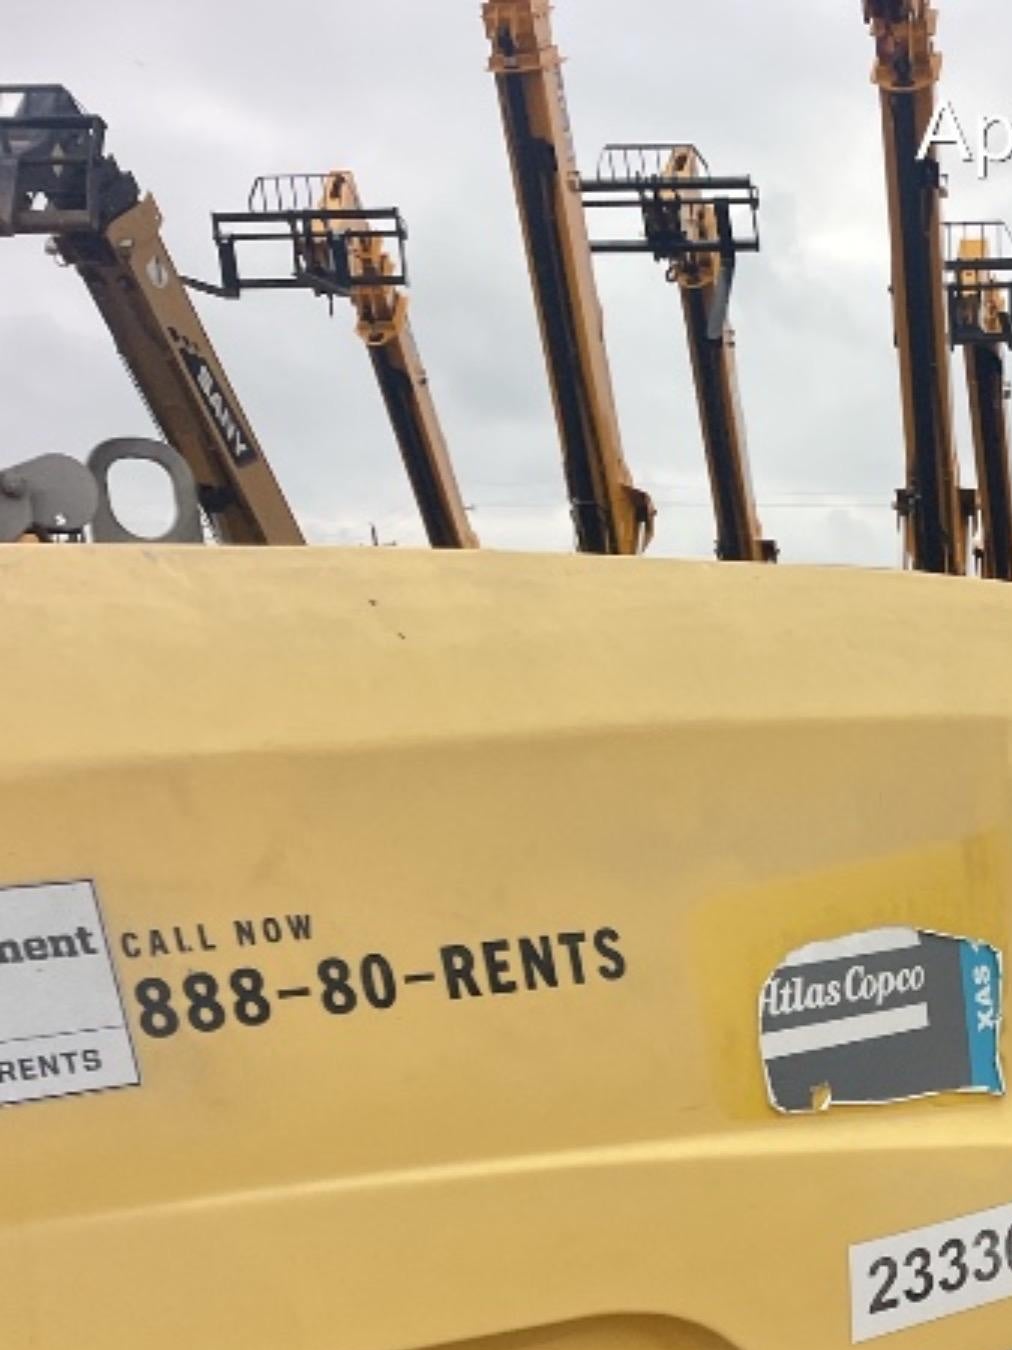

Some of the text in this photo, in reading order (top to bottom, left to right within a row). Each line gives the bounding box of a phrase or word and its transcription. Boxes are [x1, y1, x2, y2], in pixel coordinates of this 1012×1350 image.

[197, 364, 247, 457] SANY
[121, 914, 312, 958] CALL NOW
[134, 926, 627, 1039] 888-80-RENTS
[760, 965, 925, 1016] Atlas Copco
[972, 965, 994, 1032] XAS
[0, 1050, 102, 1083] RENTS
